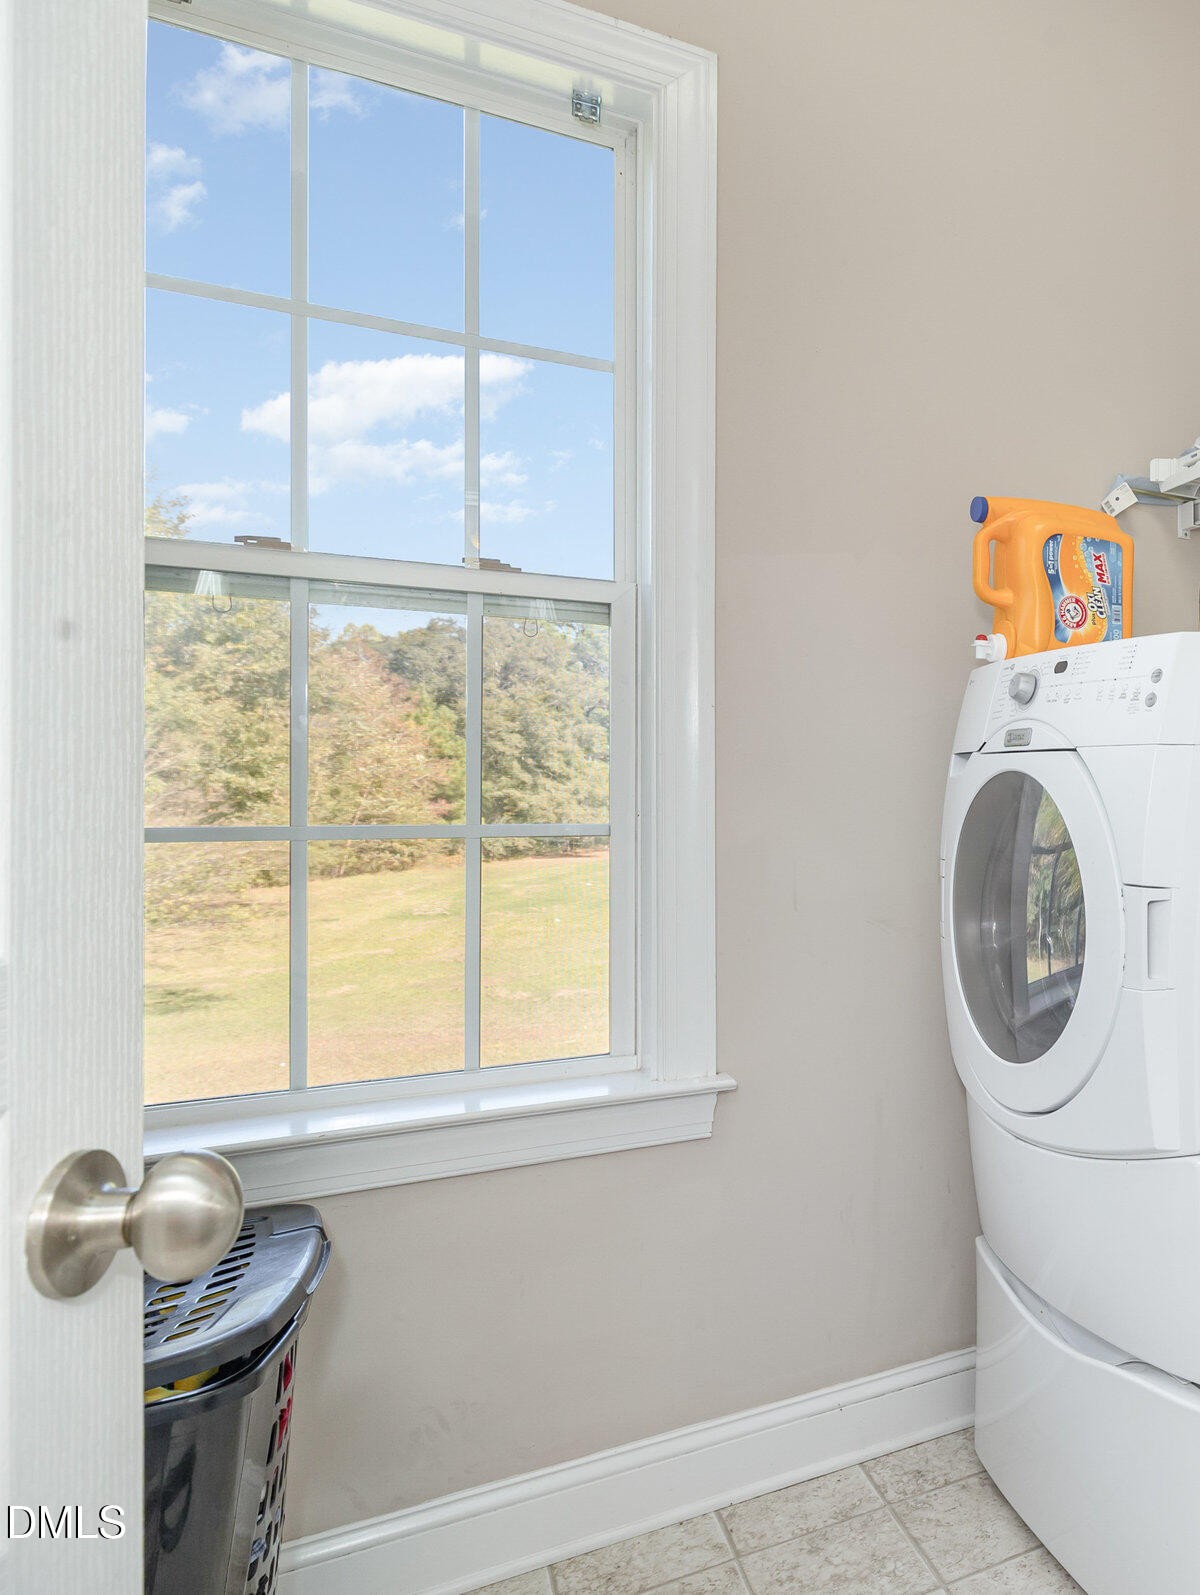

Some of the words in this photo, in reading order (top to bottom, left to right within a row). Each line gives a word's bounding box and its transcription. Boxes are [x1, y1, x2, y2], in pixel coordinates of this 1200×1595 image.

[1092, 553, 1107, 584] MAX
[1087, 592, 1098, 612] OXI
[1092, 586, 1107, 619] CLEAN
